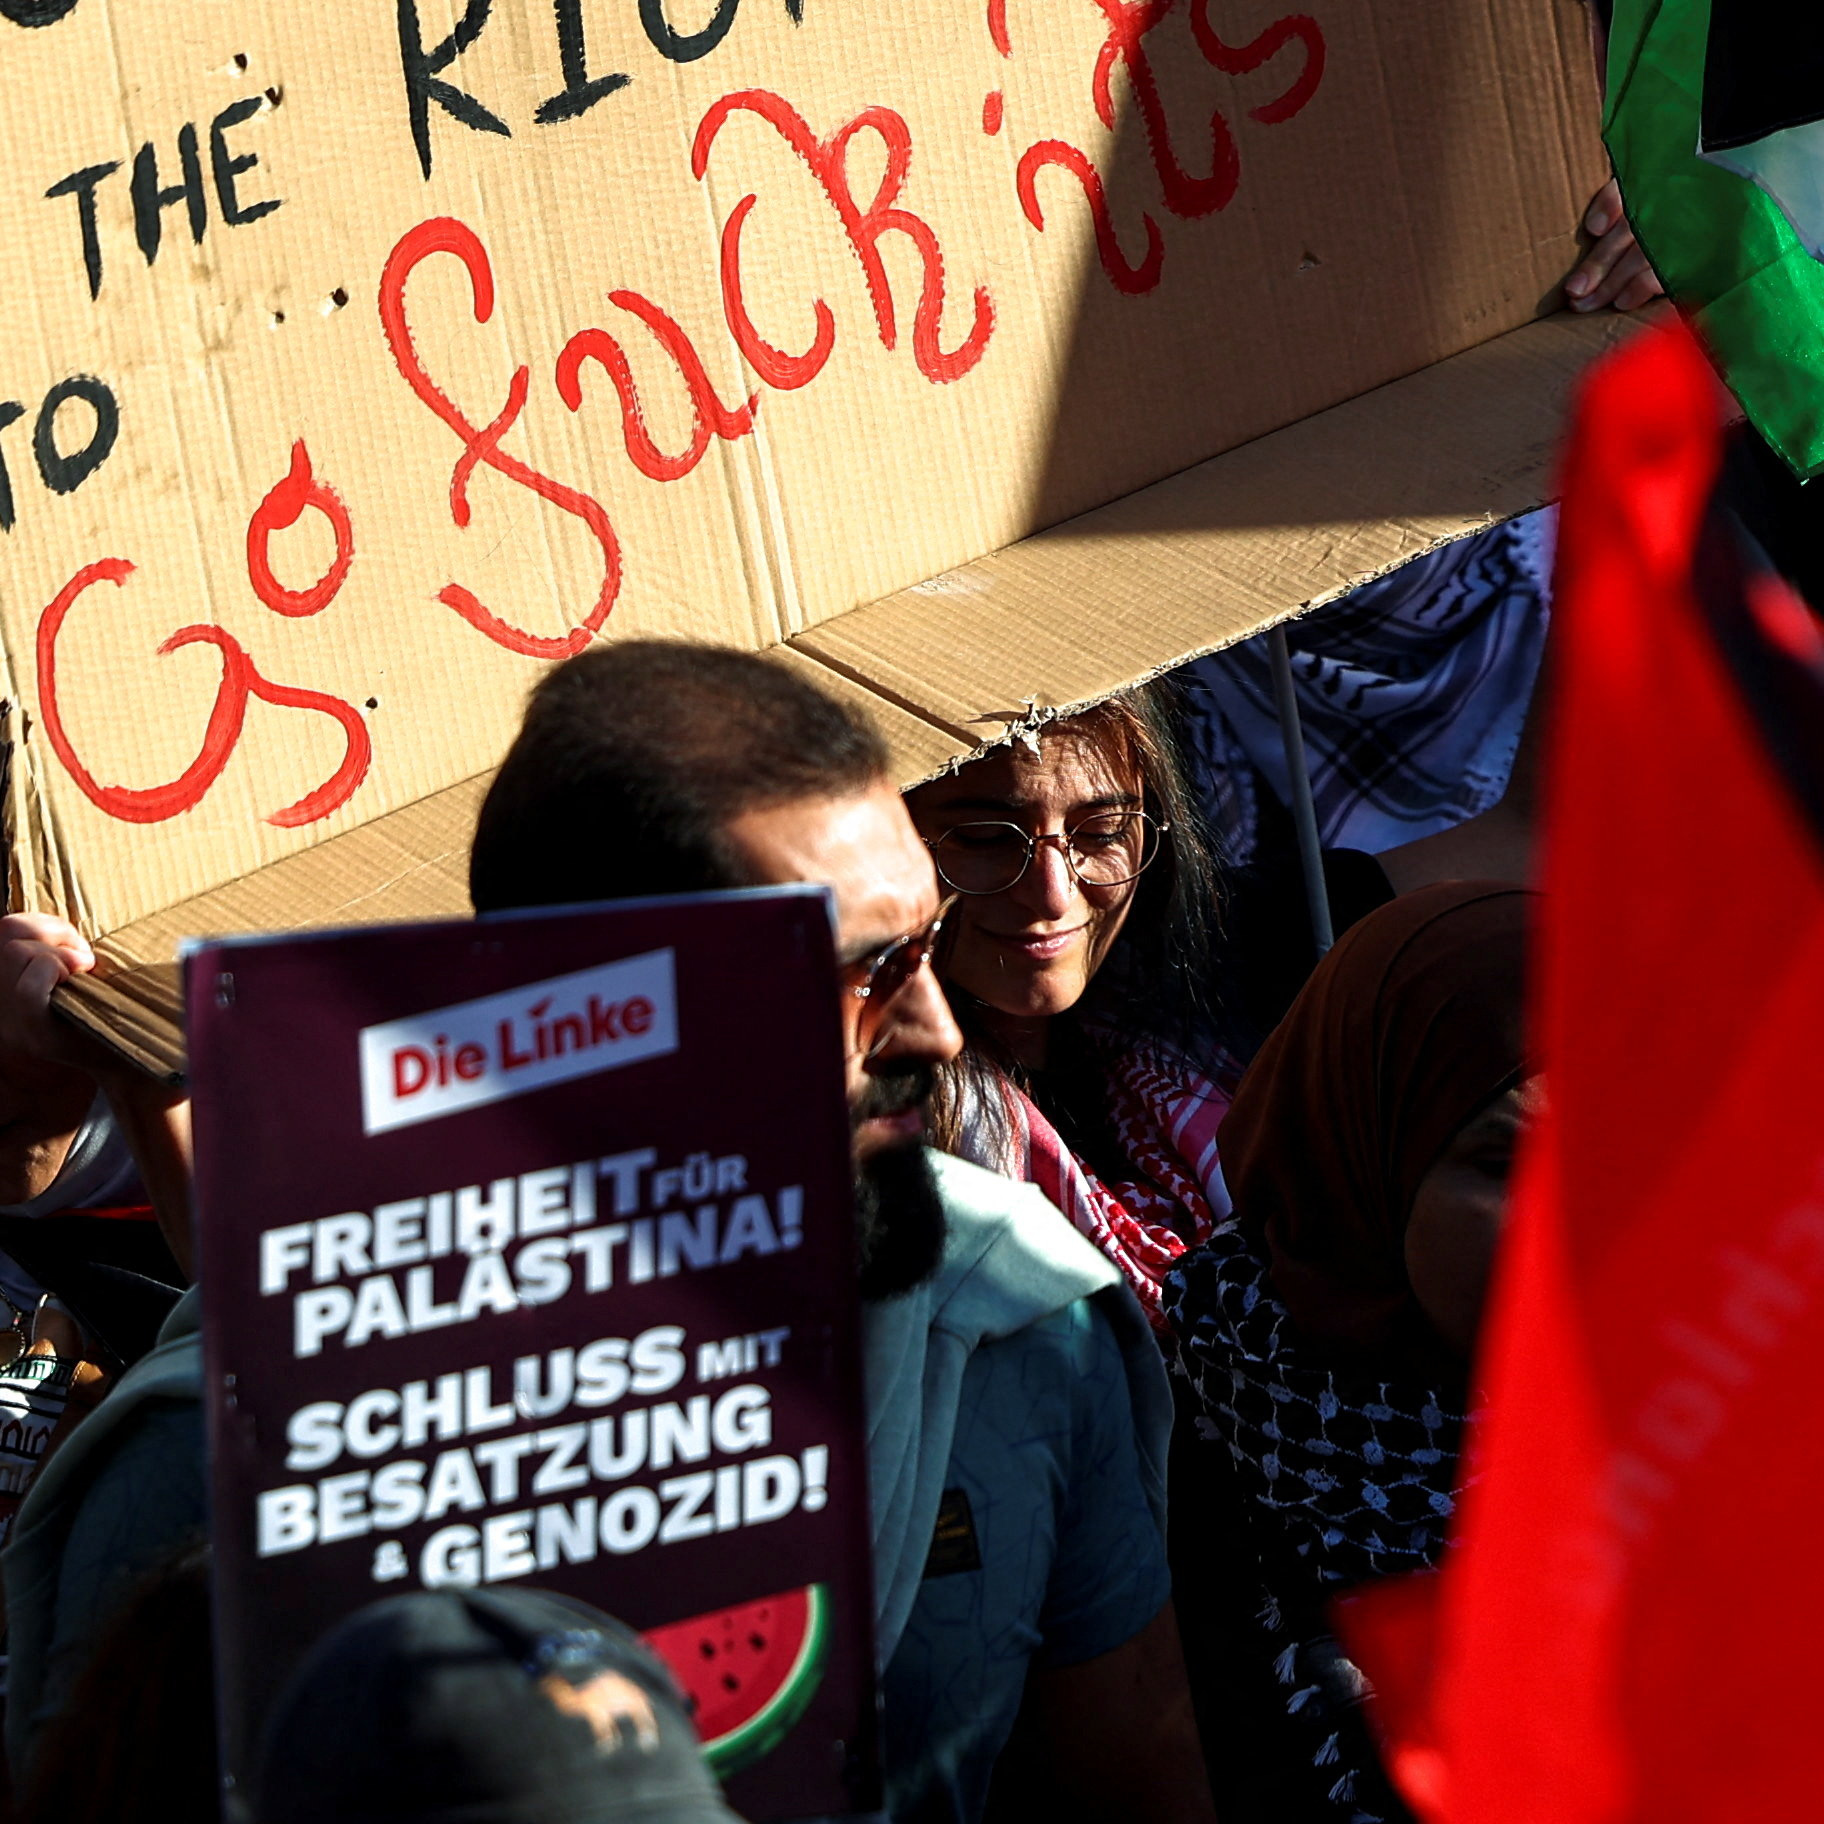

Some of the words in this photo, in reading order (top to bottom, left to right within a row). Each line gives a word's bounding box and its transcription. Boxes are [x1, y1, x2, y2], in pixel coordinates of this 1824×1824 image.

[45, 96, 284, 302] THE
[390, 1031, 489, 1101] Die
[496, 993, 657, 1073] Linke
[258, 1146, 658, 1297] FREIHEIT
[649, 1150, 748, 1210] FÜR
[292, 1184, 804, 1360] PALÄSTINA!
[255, 1382, 774, 1559] BESATZUNG
[283, 1324, 687, 1472] SCHLUSS
[696, 1326, 792, 1384] MIT
[370, 1539, 409, 1582] &
[418, 1442, 830, 1590] GENOZID!
